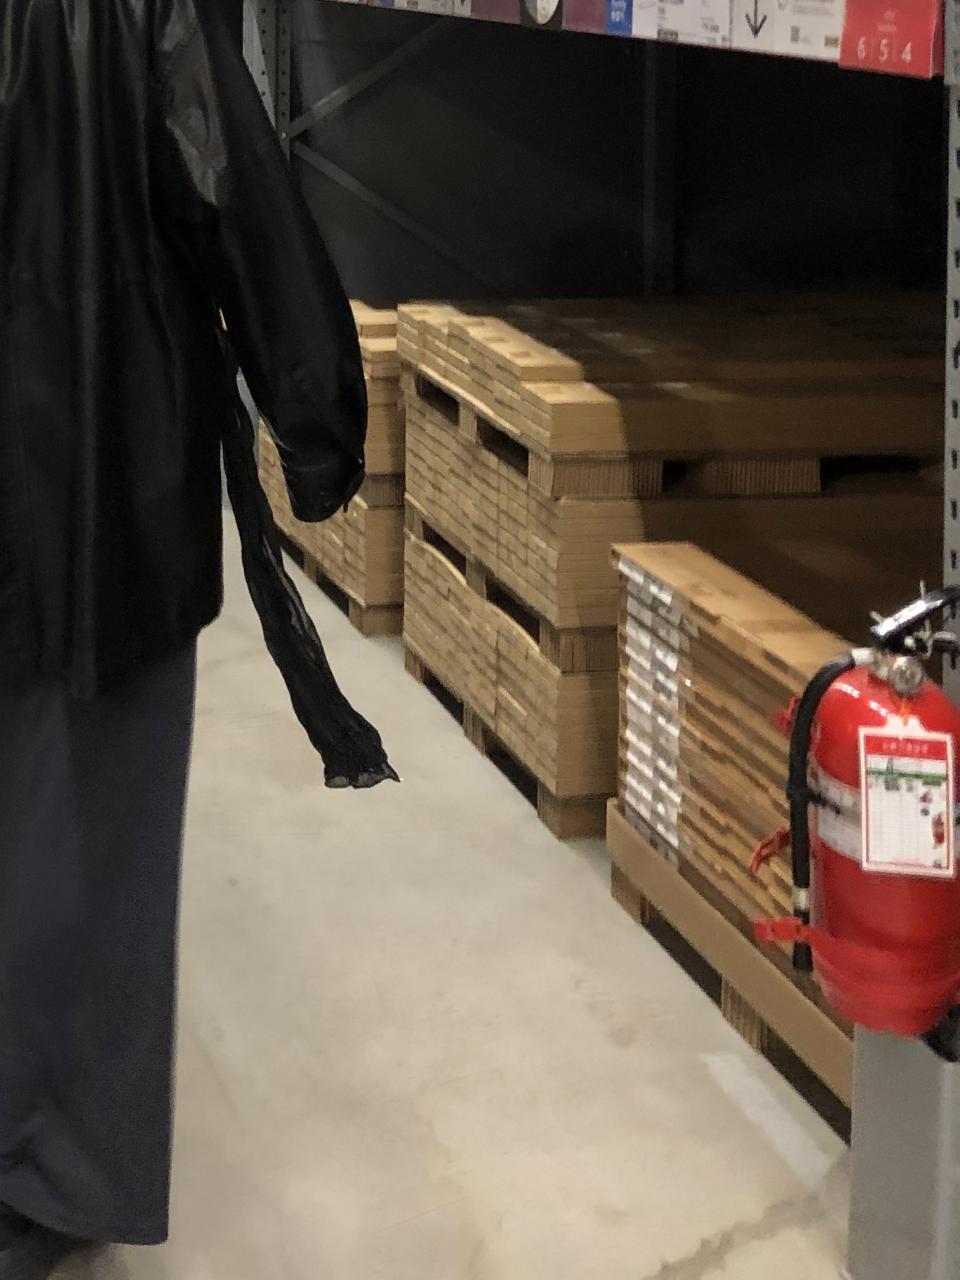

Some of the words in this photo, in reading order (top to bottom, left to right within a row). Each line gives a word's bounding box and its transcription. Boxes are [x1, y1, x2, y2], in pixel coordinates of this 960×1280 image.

[857, 36, 866, 60] 6
[878, 38, 888, 64] 5
[901, 40, 912, 65] 4
